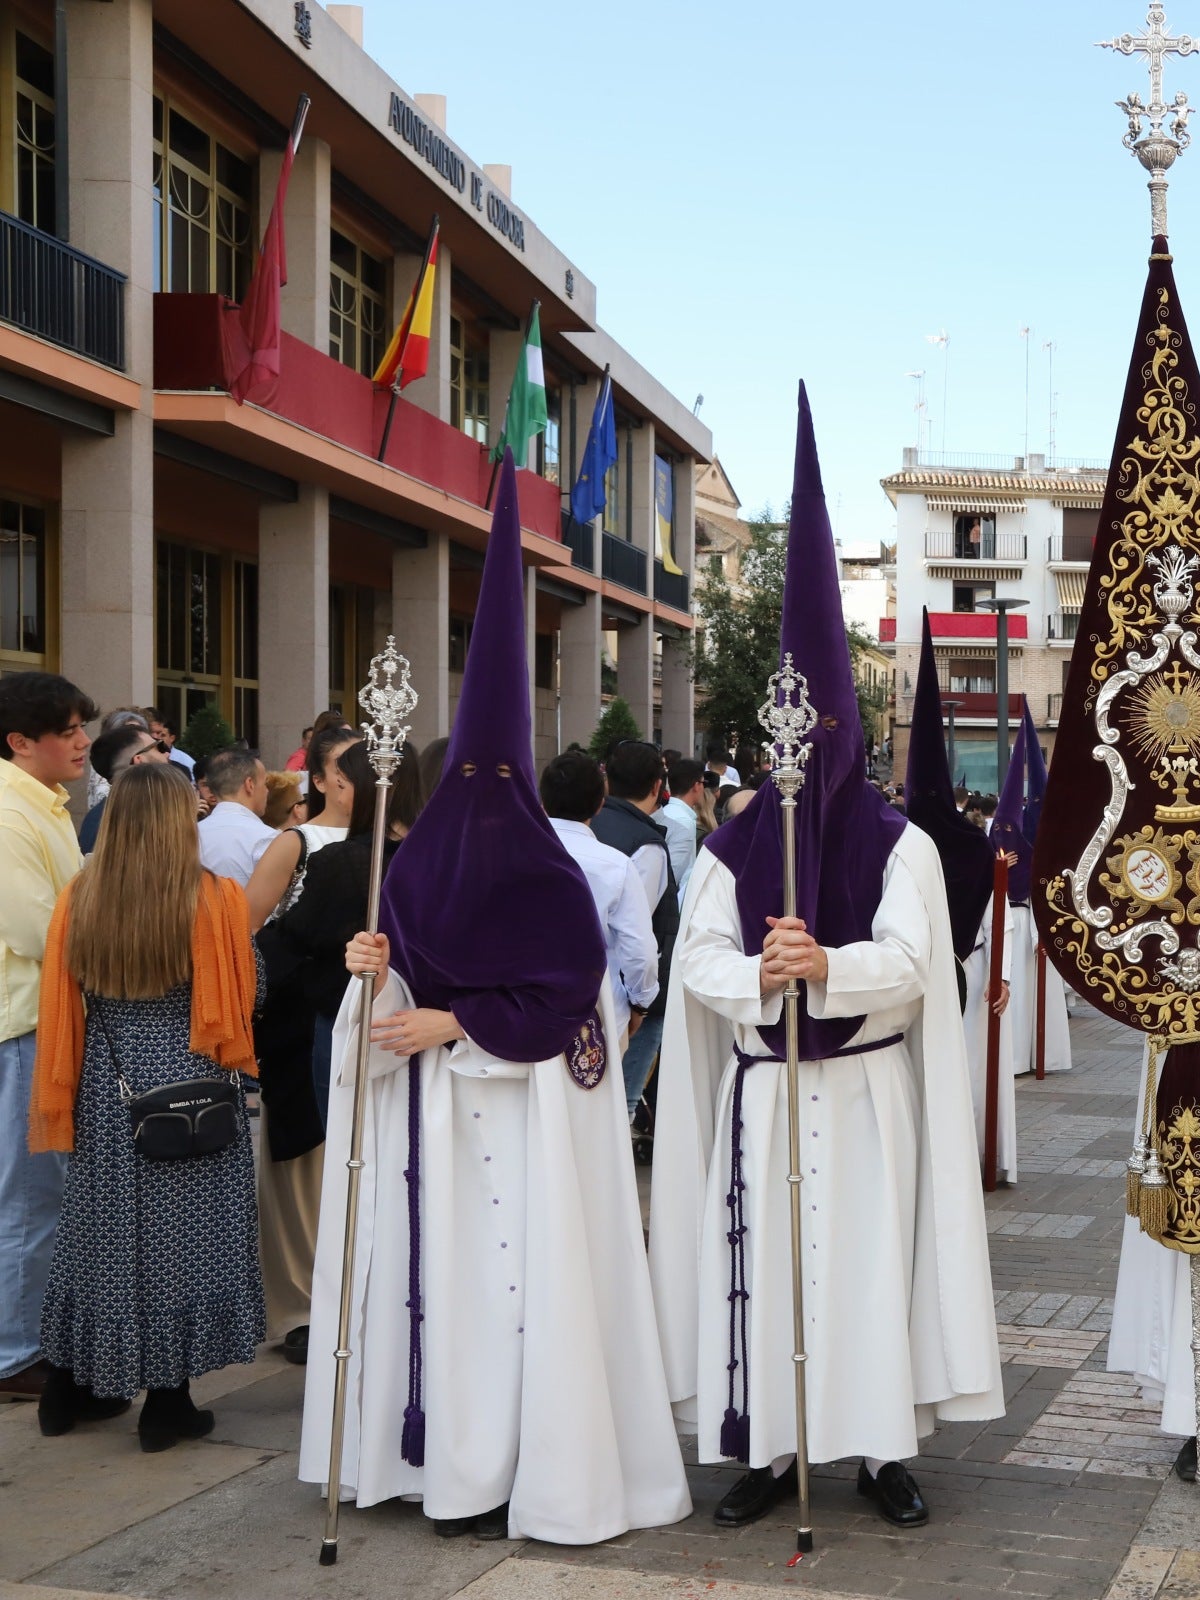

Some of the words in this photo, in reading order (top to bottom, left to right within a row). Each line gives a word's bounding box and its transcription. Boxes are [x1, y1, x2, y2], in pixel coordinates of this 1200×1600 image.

[388, 91, 465, 194] AYUNTAMIENTO
[470, 171, 483, 212] DE
[169, 1101, 190, 1109] BIMBA
[196, 1097, 212, 1105] LOLA
